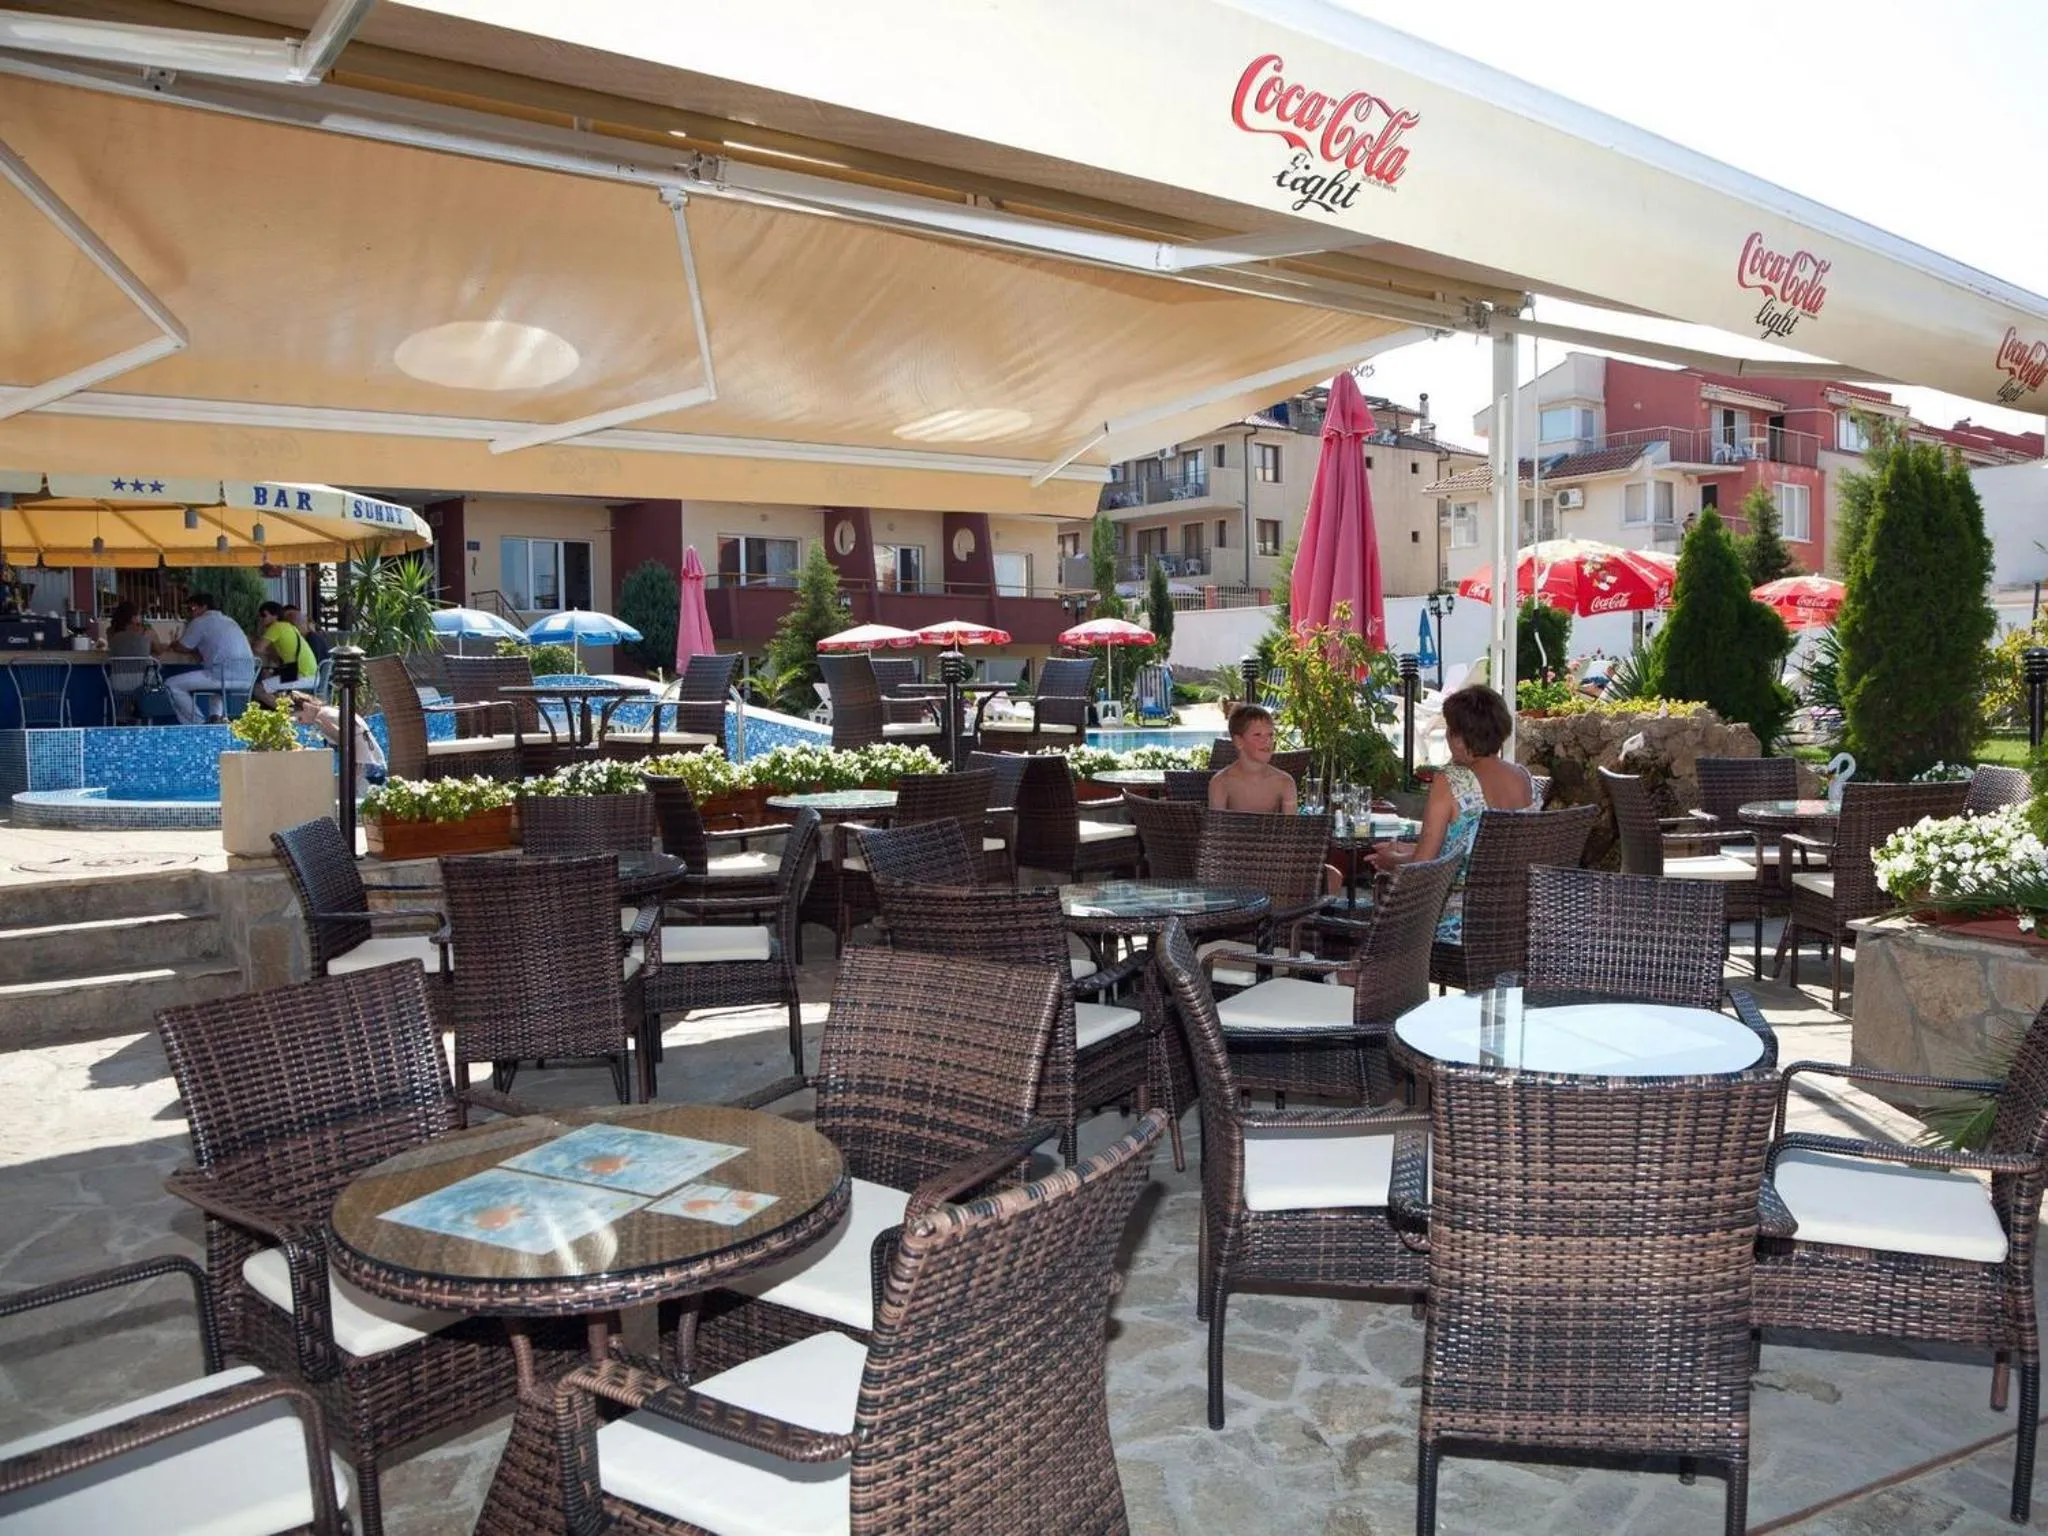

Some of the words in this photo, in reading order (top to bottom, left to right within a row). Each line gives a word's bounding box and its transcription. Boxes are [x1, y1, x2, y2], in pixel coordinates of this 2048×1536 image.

[1231, 53, 1421, 184] Coca-Cola
[1737, 231, 1832, 314] Coca-Cola
[1754, 298, 1800, 340] light
[253, 486, 313, 512] BAR
